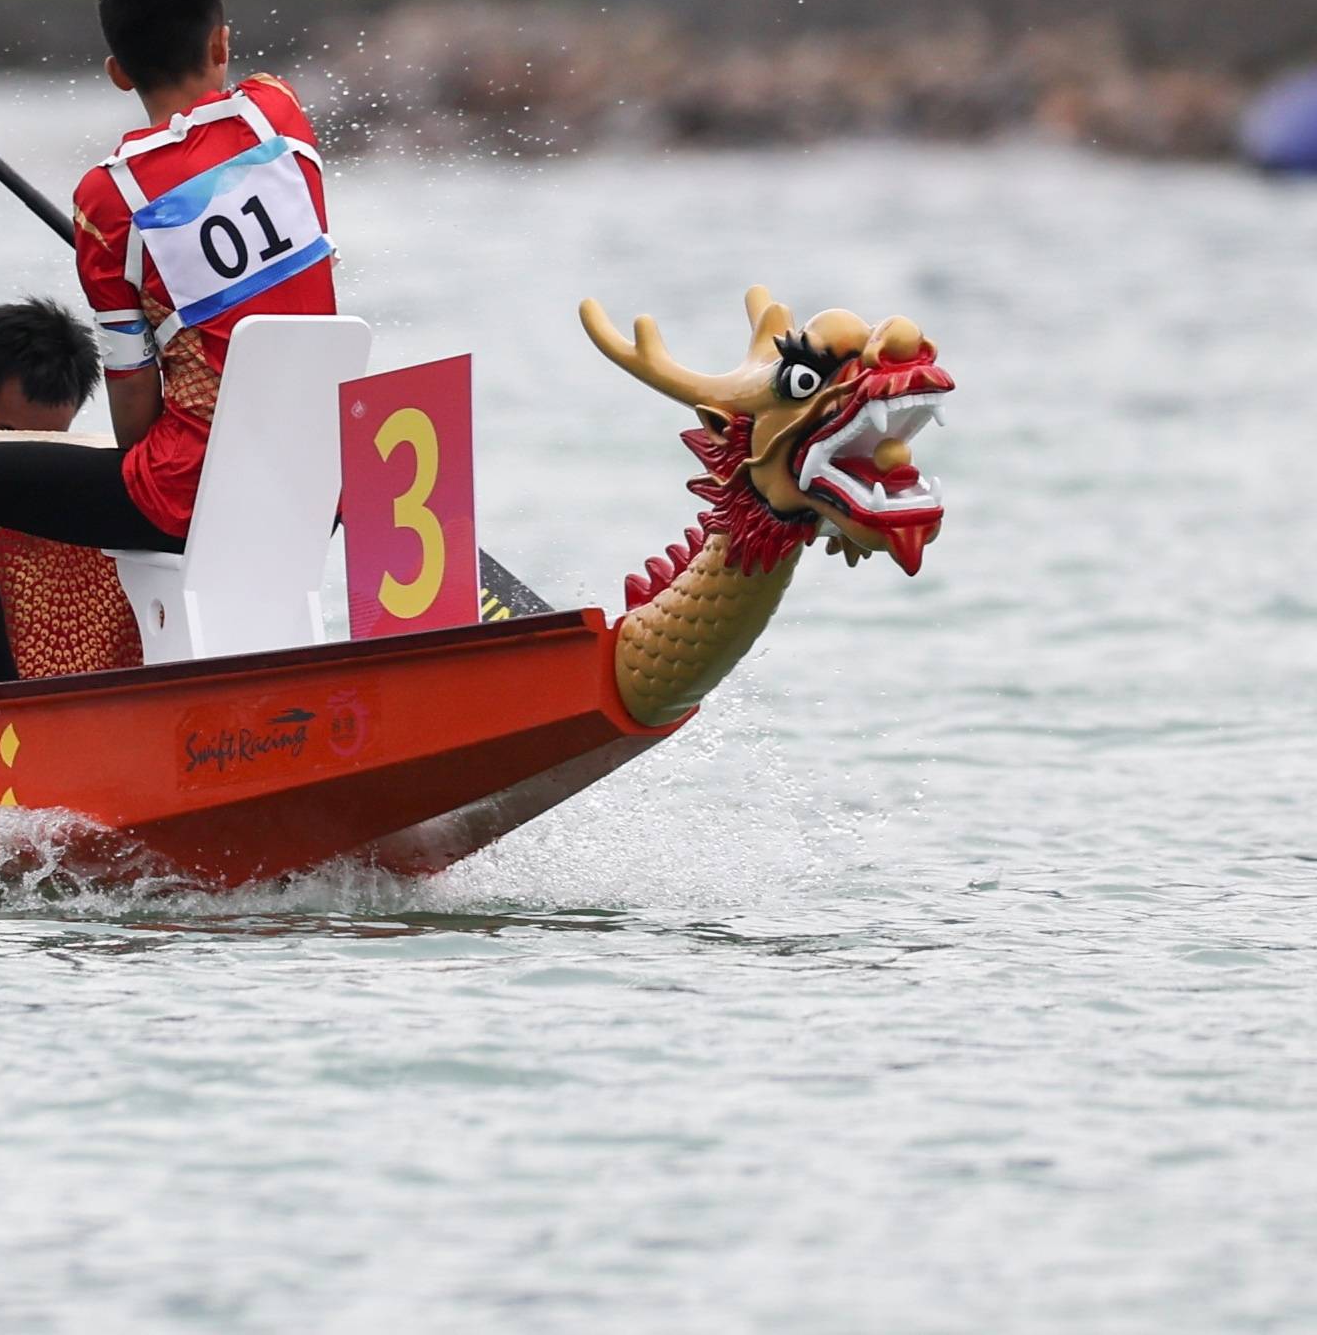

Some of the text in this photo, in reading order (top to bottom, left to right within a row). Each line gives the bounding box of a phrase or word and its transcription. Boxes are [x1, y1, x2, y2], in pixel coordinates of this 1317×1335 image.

[200, 195, 293, 279] 01
[374, 408, 445, 618] 3
[185, 729, 234, 773] Swift
[239, 725, 309, 763] Racing
